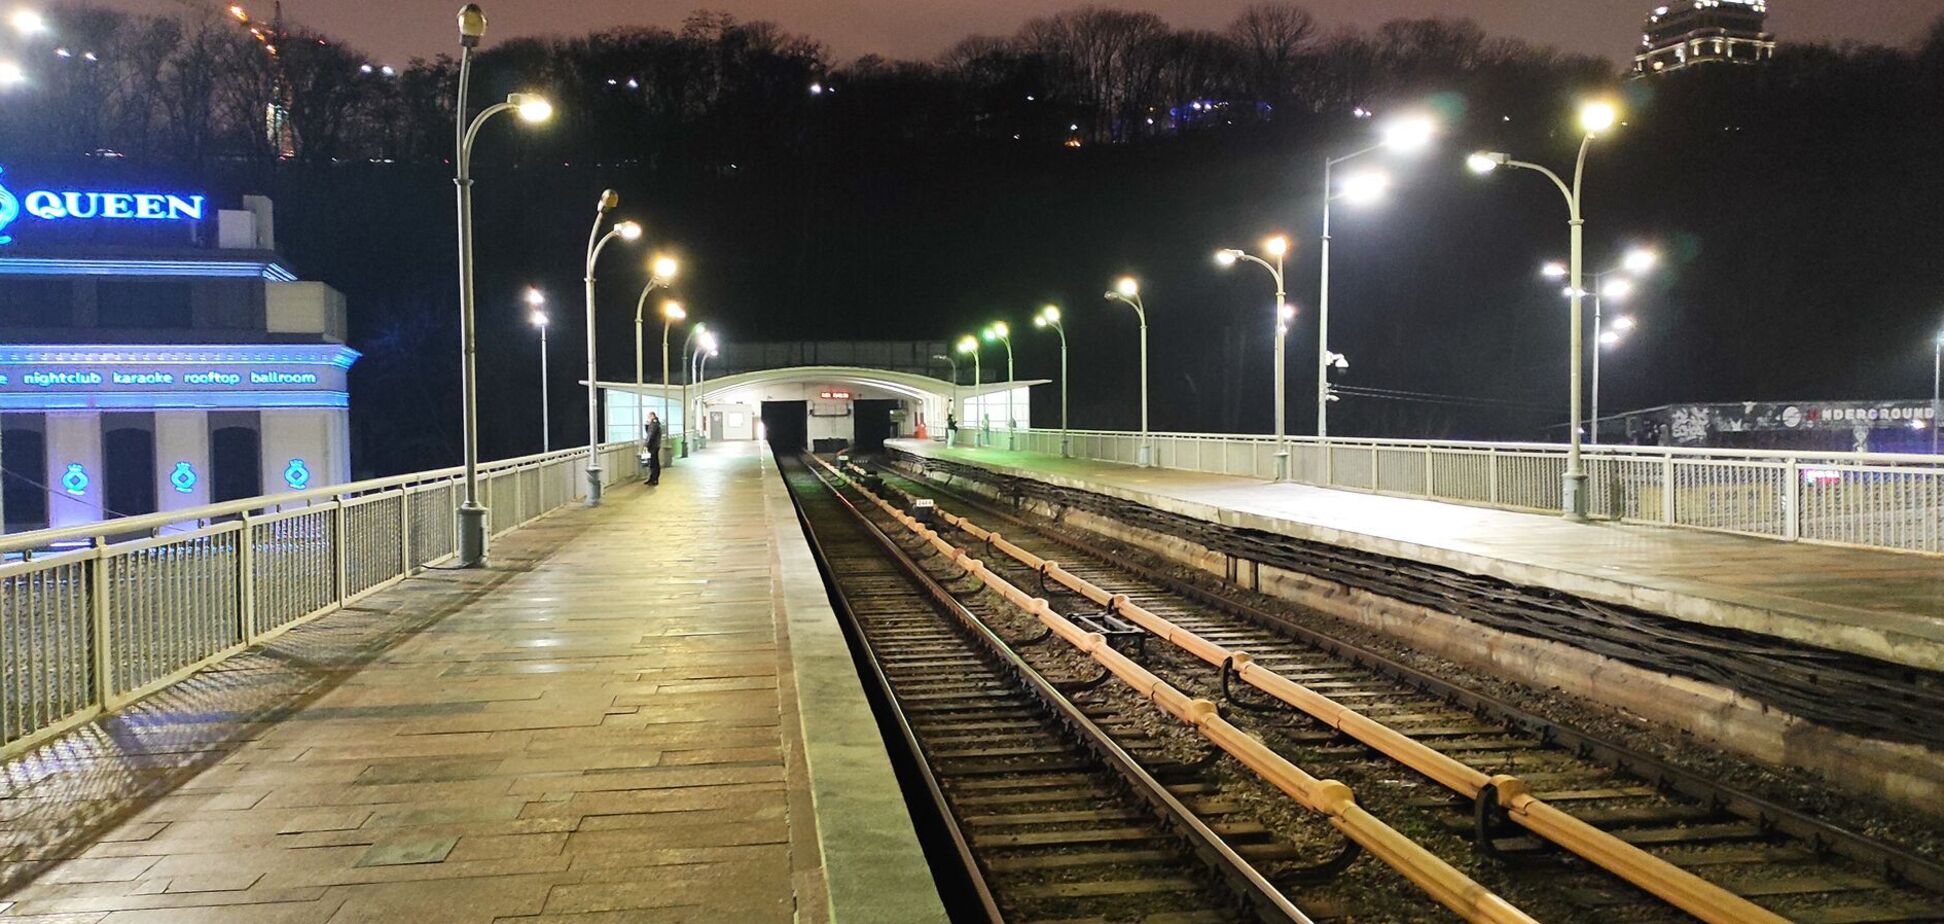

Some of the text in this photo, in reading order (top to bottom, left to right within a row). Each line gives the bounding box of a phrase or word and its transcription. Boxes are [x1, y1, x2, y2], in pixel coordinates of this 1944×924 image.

[25, 190, 206, 220] QUEEN
[24, 371, 102, 387] nightclub
[112, 371, 174, 385] karaoke
[184, 371, 240, 385] rooftop
[250, 371, 316, 384] ballroom
